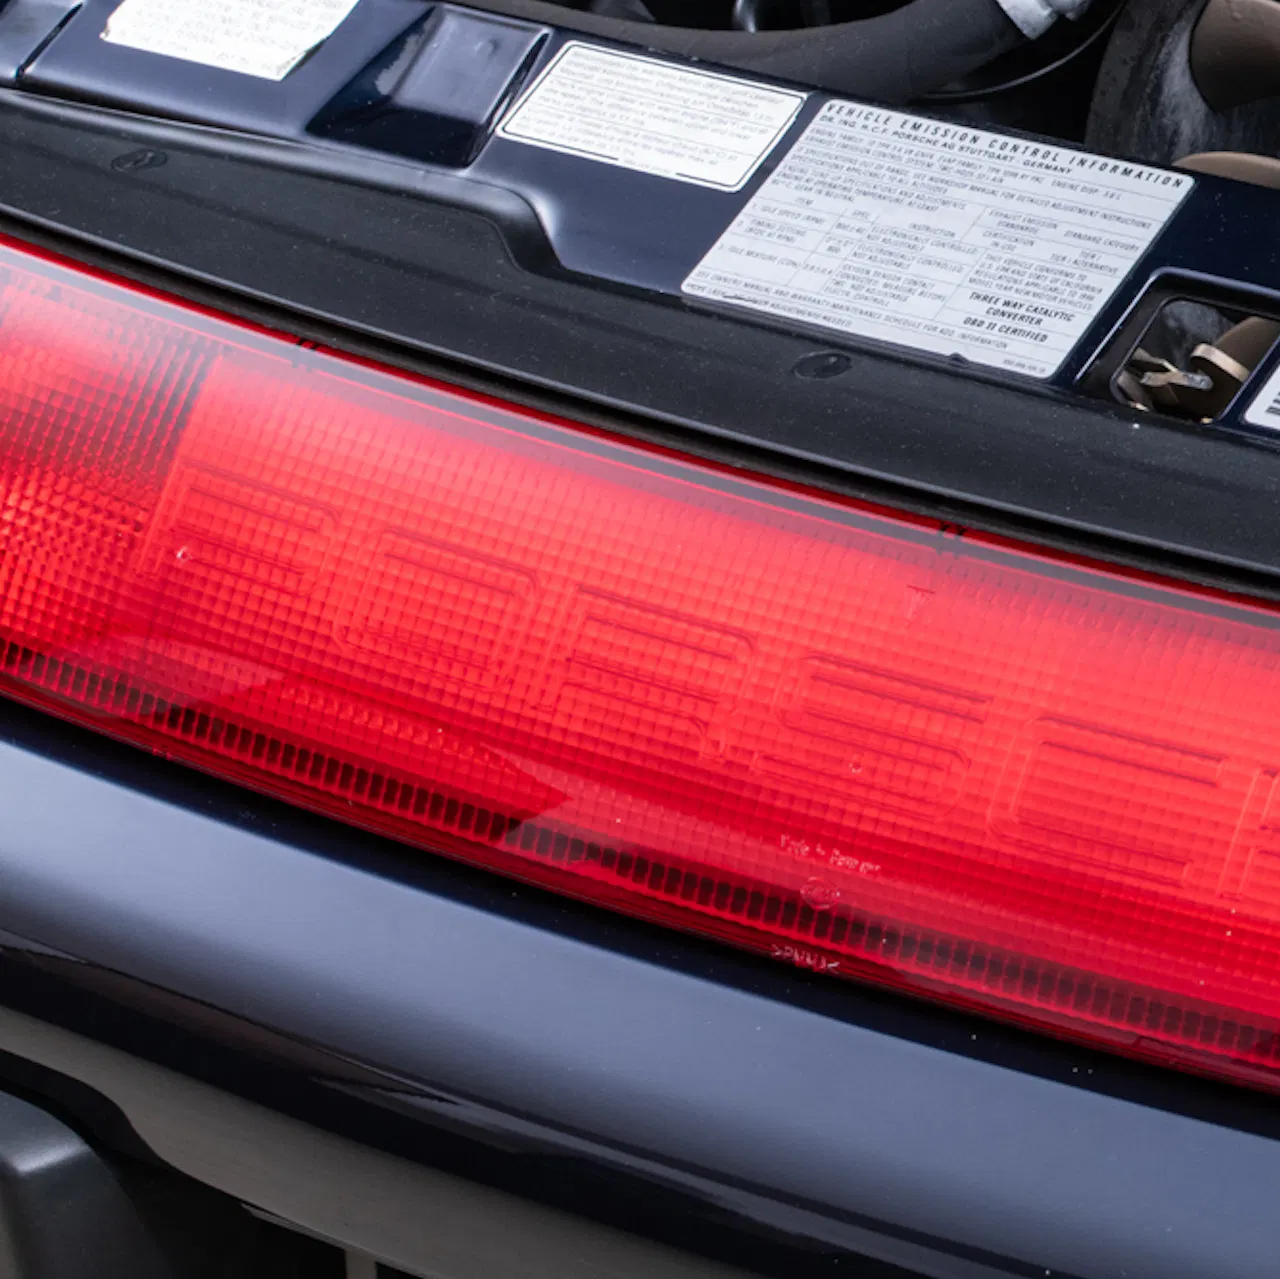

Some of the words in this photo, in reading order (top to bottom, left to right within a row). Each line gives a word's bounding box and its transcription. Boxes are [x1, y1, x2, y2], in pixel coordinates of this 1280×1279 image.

[826, 103, 891, 124] VEHICLE
[899, 119, 979, 144] EMISSION
[987, 138, 1060, 162] CONTROL
[1067, 155, 1182, 189] INFORMATION
[891, 130, 939, 146] PORSCHE
[957, 144, 1014, 162] STUTTGART
[1022, 158, 1071, 175] GERMANY
[969, 292, 1000, 304] THREE
[1001, 299, 1024, 310] WAY
[1025, 304, 1075, 321] CATALYTIC
[985, 306, 1042, 325] CONVERTER
[963, 317, 985, 327] OBD
[986, 322, 996, 330] II
[997, 324, 1048, 342] CERTIFIED
